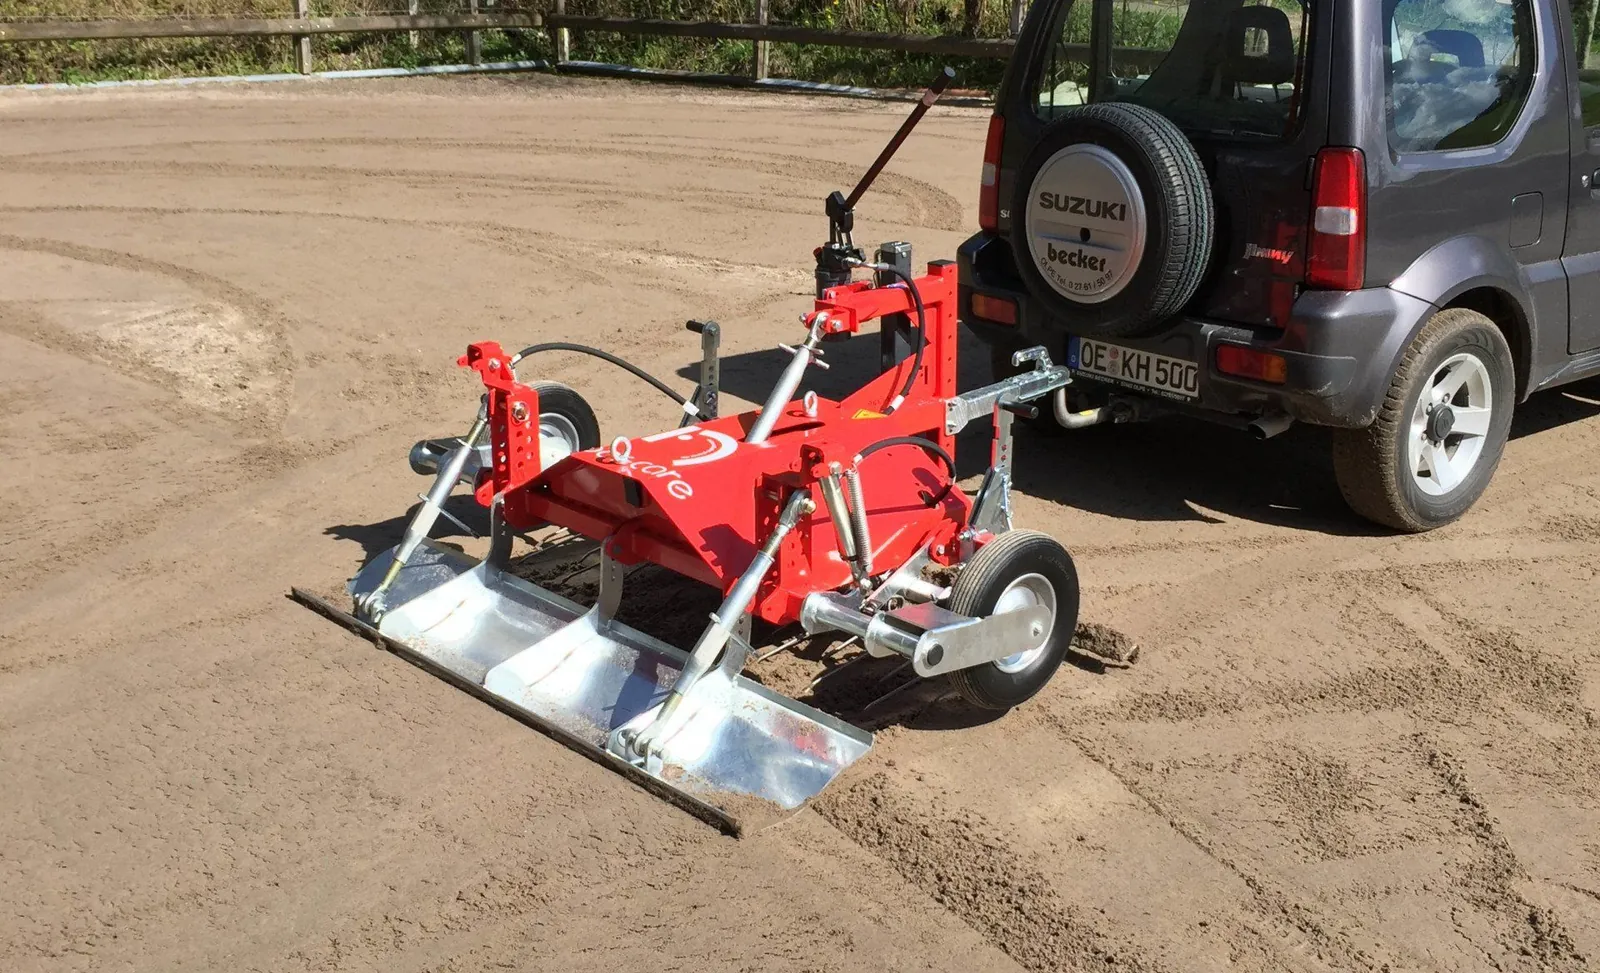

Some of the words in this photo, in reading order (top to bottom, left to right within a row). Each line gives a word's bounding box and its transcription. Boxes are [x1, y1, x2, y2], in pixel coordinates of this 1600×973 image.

[1039, 191, 1127, 222] SUZUKI
[1047, 242, 1107, 272] becker
[1081, 341, 1107, 372] OE
[1121, 350, 1150, 382] KH
[1155, 358, 1198, 393] 500
